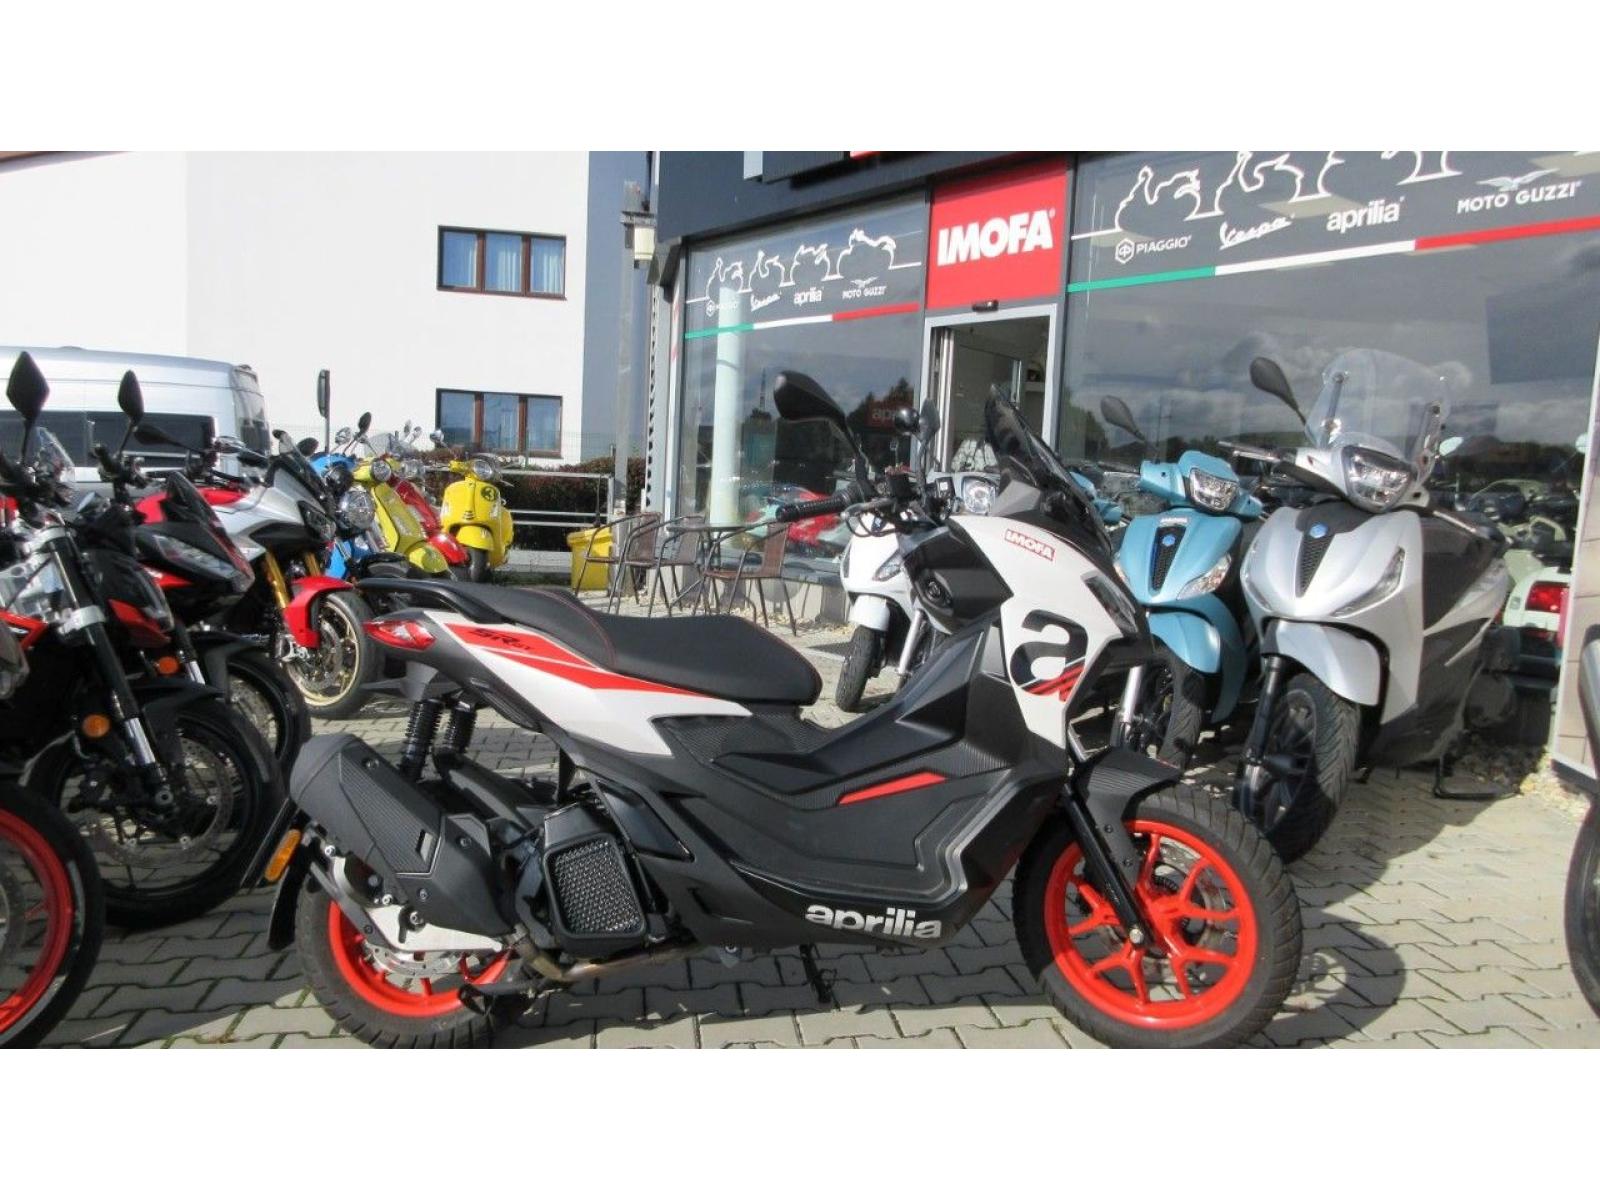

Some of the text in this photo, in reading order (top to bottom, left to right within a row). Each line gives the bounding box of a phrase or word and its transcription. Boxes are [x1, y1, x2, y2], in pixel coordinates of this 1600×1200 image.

[1457, 182, 1577, 214] MOTO GUZZI
[1218, 216, 1293, 250] Vespa
[1326, 200, 1401, 234] aprilia
[937, 209, 1053, 267] IMOFA
[1136, 237, 1188, 255] PIAGGIO
[793, 286, 822, 307] aprilia
[1006, 530, 1055, 559] IMOFA
[805, 904, 942, 939] aprilia
